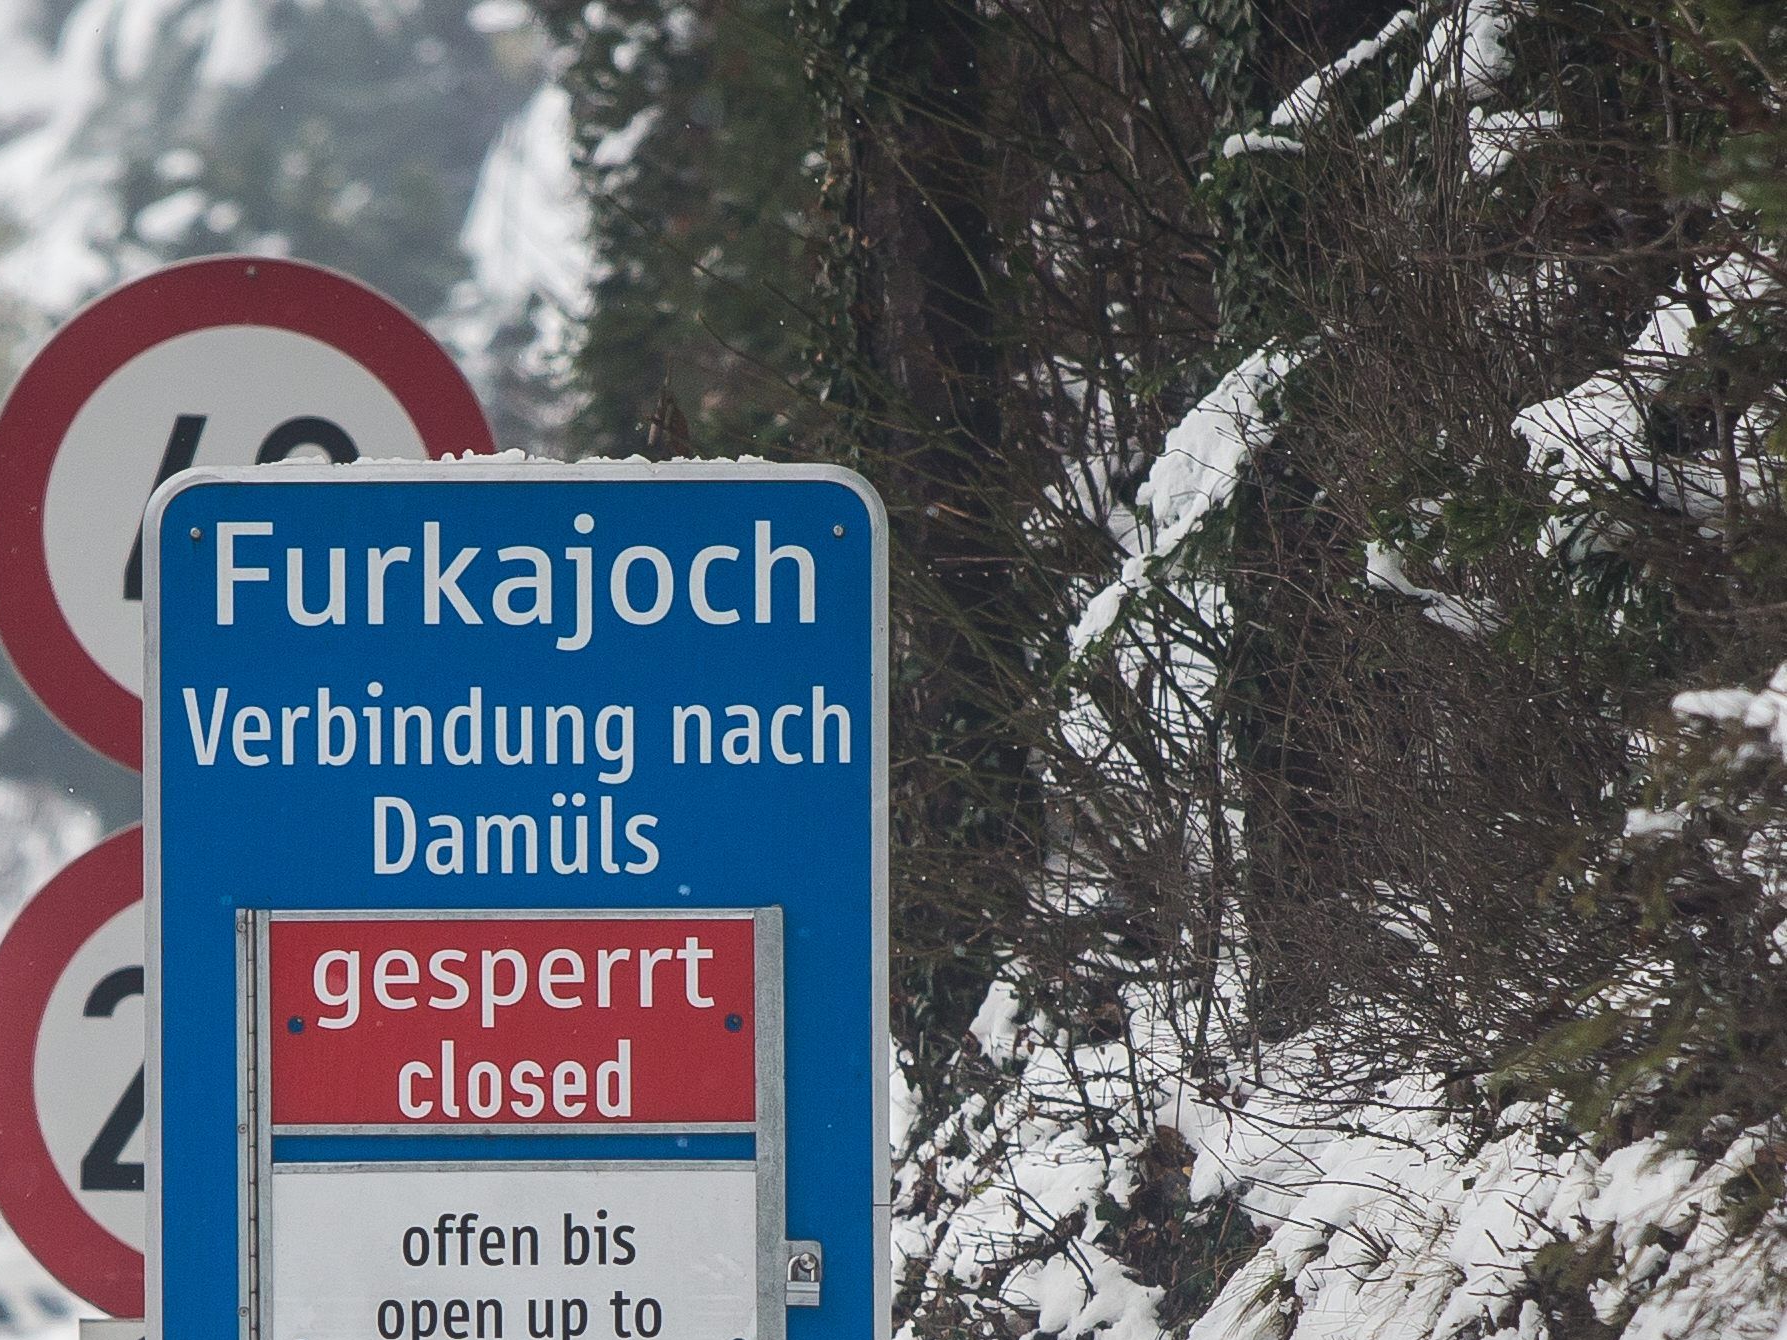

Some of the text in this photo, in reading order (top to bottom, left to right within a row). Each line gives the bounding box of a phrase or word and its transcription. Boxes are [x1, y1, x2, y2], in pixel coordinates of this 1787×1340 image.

[216, 513, 816, 651] Furkajoch
[182, 681, 852, 785] Verbindung nach
[373, 792, 660, 875] Damüls
[313, 936, 715, 1030] gesperrt
[398, 1038, 632, 1119] closed
[402, 1209, 636, 1267] offen bis
[609, 1290, 662, 1339] to
